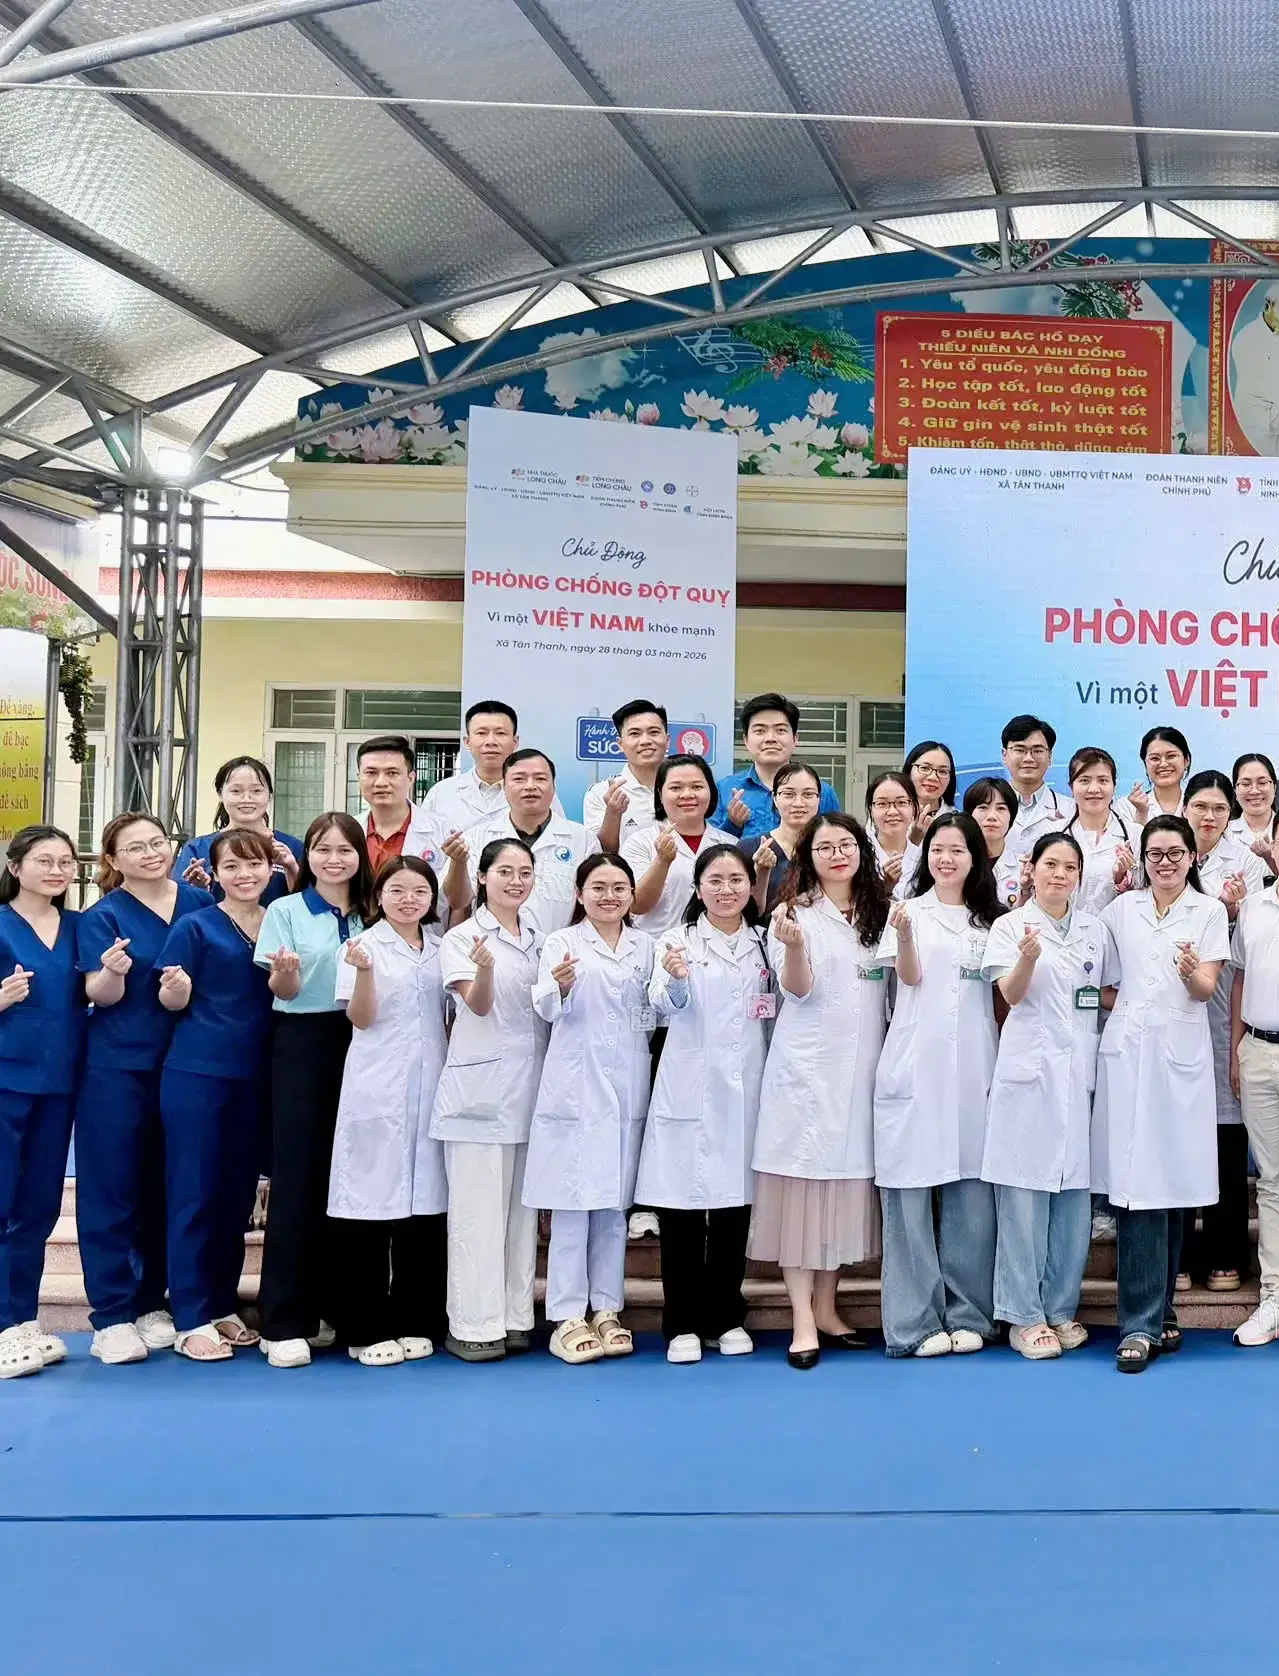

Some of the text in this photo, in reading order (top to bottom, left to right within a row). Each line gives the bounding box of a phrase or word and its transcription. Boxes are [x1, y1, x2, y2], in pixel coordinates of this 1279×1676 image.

[1000, 329, 1035, 340] BÁC
[1068, 334, 1104, 345] DẠY
[918, 340, 966, 352] THIẾU
[971, 342, 1011, 353] NIÊN
[1015, 344, 1039, 355] VÀ
[1044, 347, 1073, 356] NHI
[900, 357, 1148, 378] 1. Yêu tổ quốc, yêu đồng bào
[898, 377, 1148, 398] 2. Học tập tốt, lao động tốt
[898, 397, 916, 408] 3.
[921, 397, 971, 410] Đoàn
[977, 398, 1007, 411] kết
[1012, 398, 1045, 414] tốt,
[1079, 402, 1115, 418] luật
[1120, 403, 1148, 417] tốt
[561, 537, 646, 569] Chủ Động
[471, 568, 731, 608] PHÒNG CHỐNG ĐỘT QUỴ
[487, 611, 500, 622] Vì
[504, 613, 529, 626] một
[532, 606, 584, 631] VIỆT
[590, 613, 644, 632] NAM
[681, 626, 715, 637] mạnh
[1044, 598, 1199, 646] PHÒNG
[495, 639, 707, 660] Xã Tân Thanh, ngày 28 tháng 03 năm 2026
[1075, 680, 1100, 704] Vì
[1110, 681, 1158, 710] một
[1166, 658, 1268, 719] VIỆT
